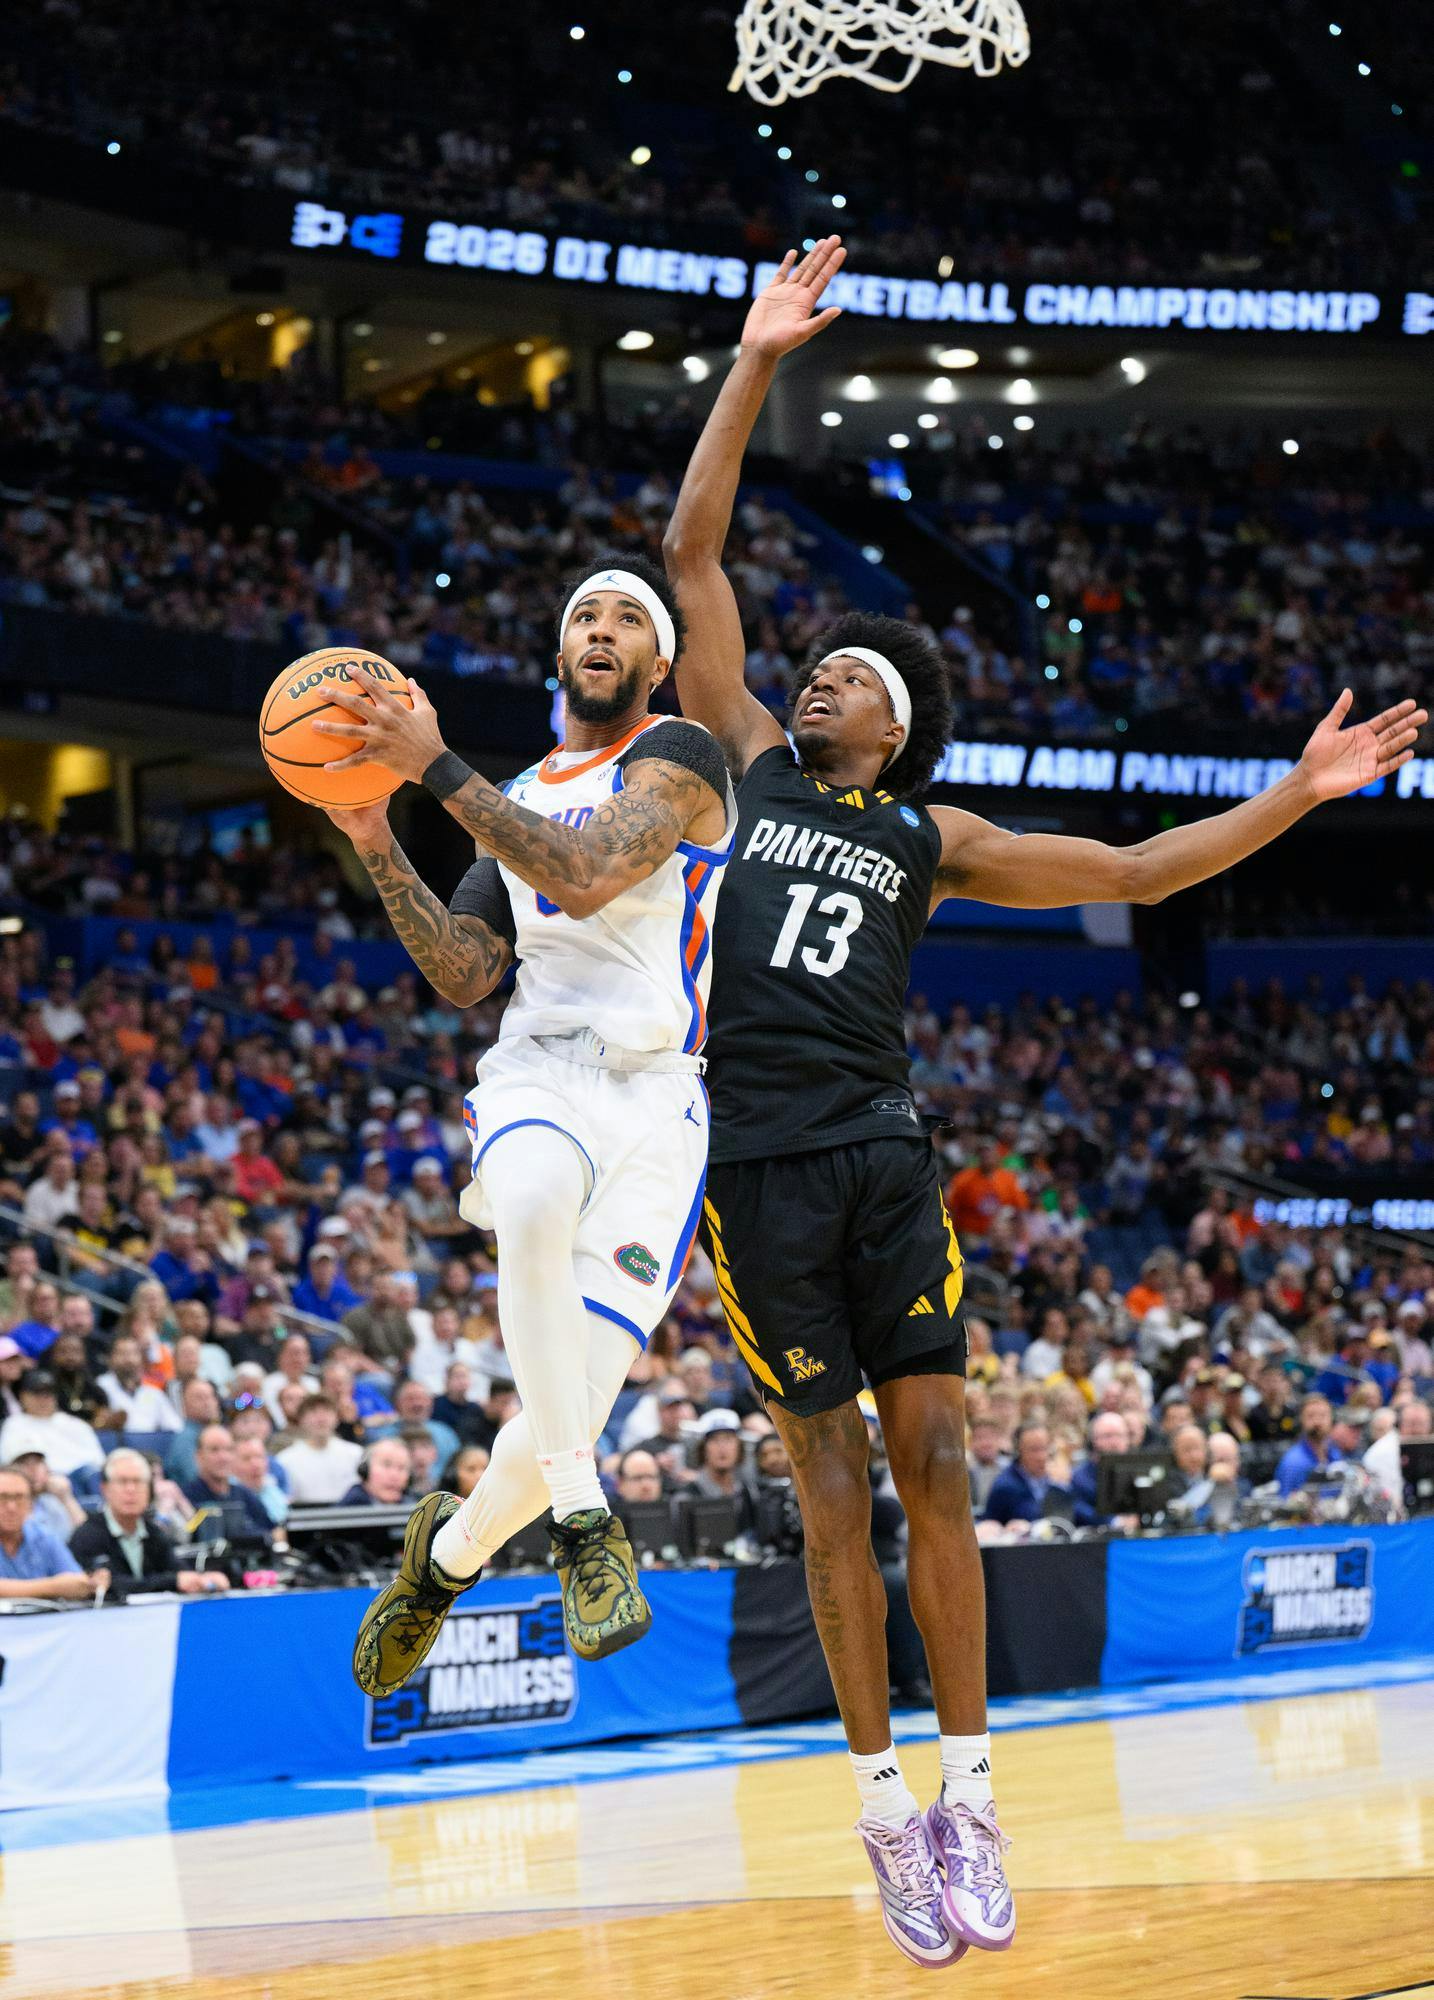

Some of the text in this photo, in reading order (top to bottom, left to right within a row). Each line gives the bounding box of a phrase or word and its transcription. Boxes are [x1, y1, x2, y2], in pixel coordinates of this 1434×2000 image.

[425, 221, 1381, 331] 2026 DI MEN'S BKETBALL CHAMPIONSHIP
[742, 818, 908, 902] PANTHERS
[769, 884, 864, 978] 13
[1264, 1553, 1337, 1596] MARCH
[1273, 1587, 1372, 1632] MADNESS
[421, 1614, 519, 1667] ARCH
[428, 1655, 574, 1714] MADNESS
